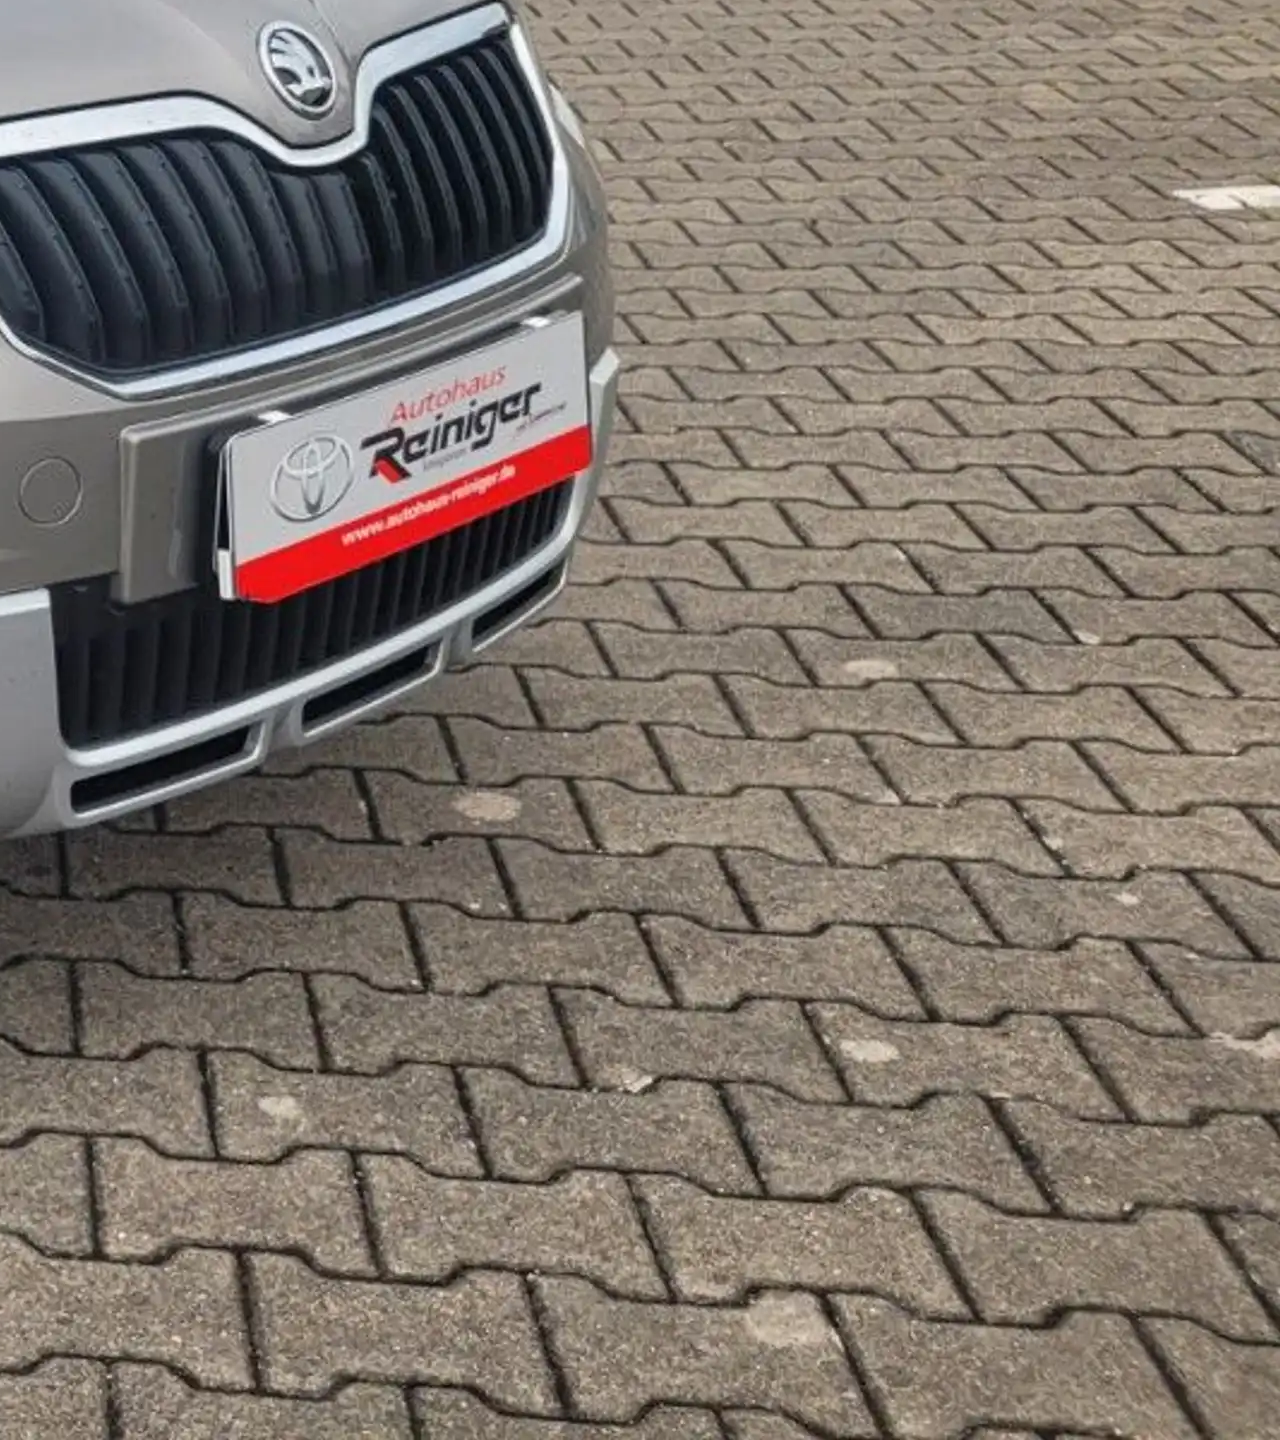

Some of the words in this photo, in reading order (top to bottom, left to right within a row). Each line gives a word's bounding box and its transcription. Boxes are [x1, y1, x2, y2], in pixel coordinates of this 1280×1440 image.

[360, 381, 542, 483] Reiniger
[392, 365, 507, 422] Autohaus
[340, 463, 517, 548] www.autohaus-reiniger.de
